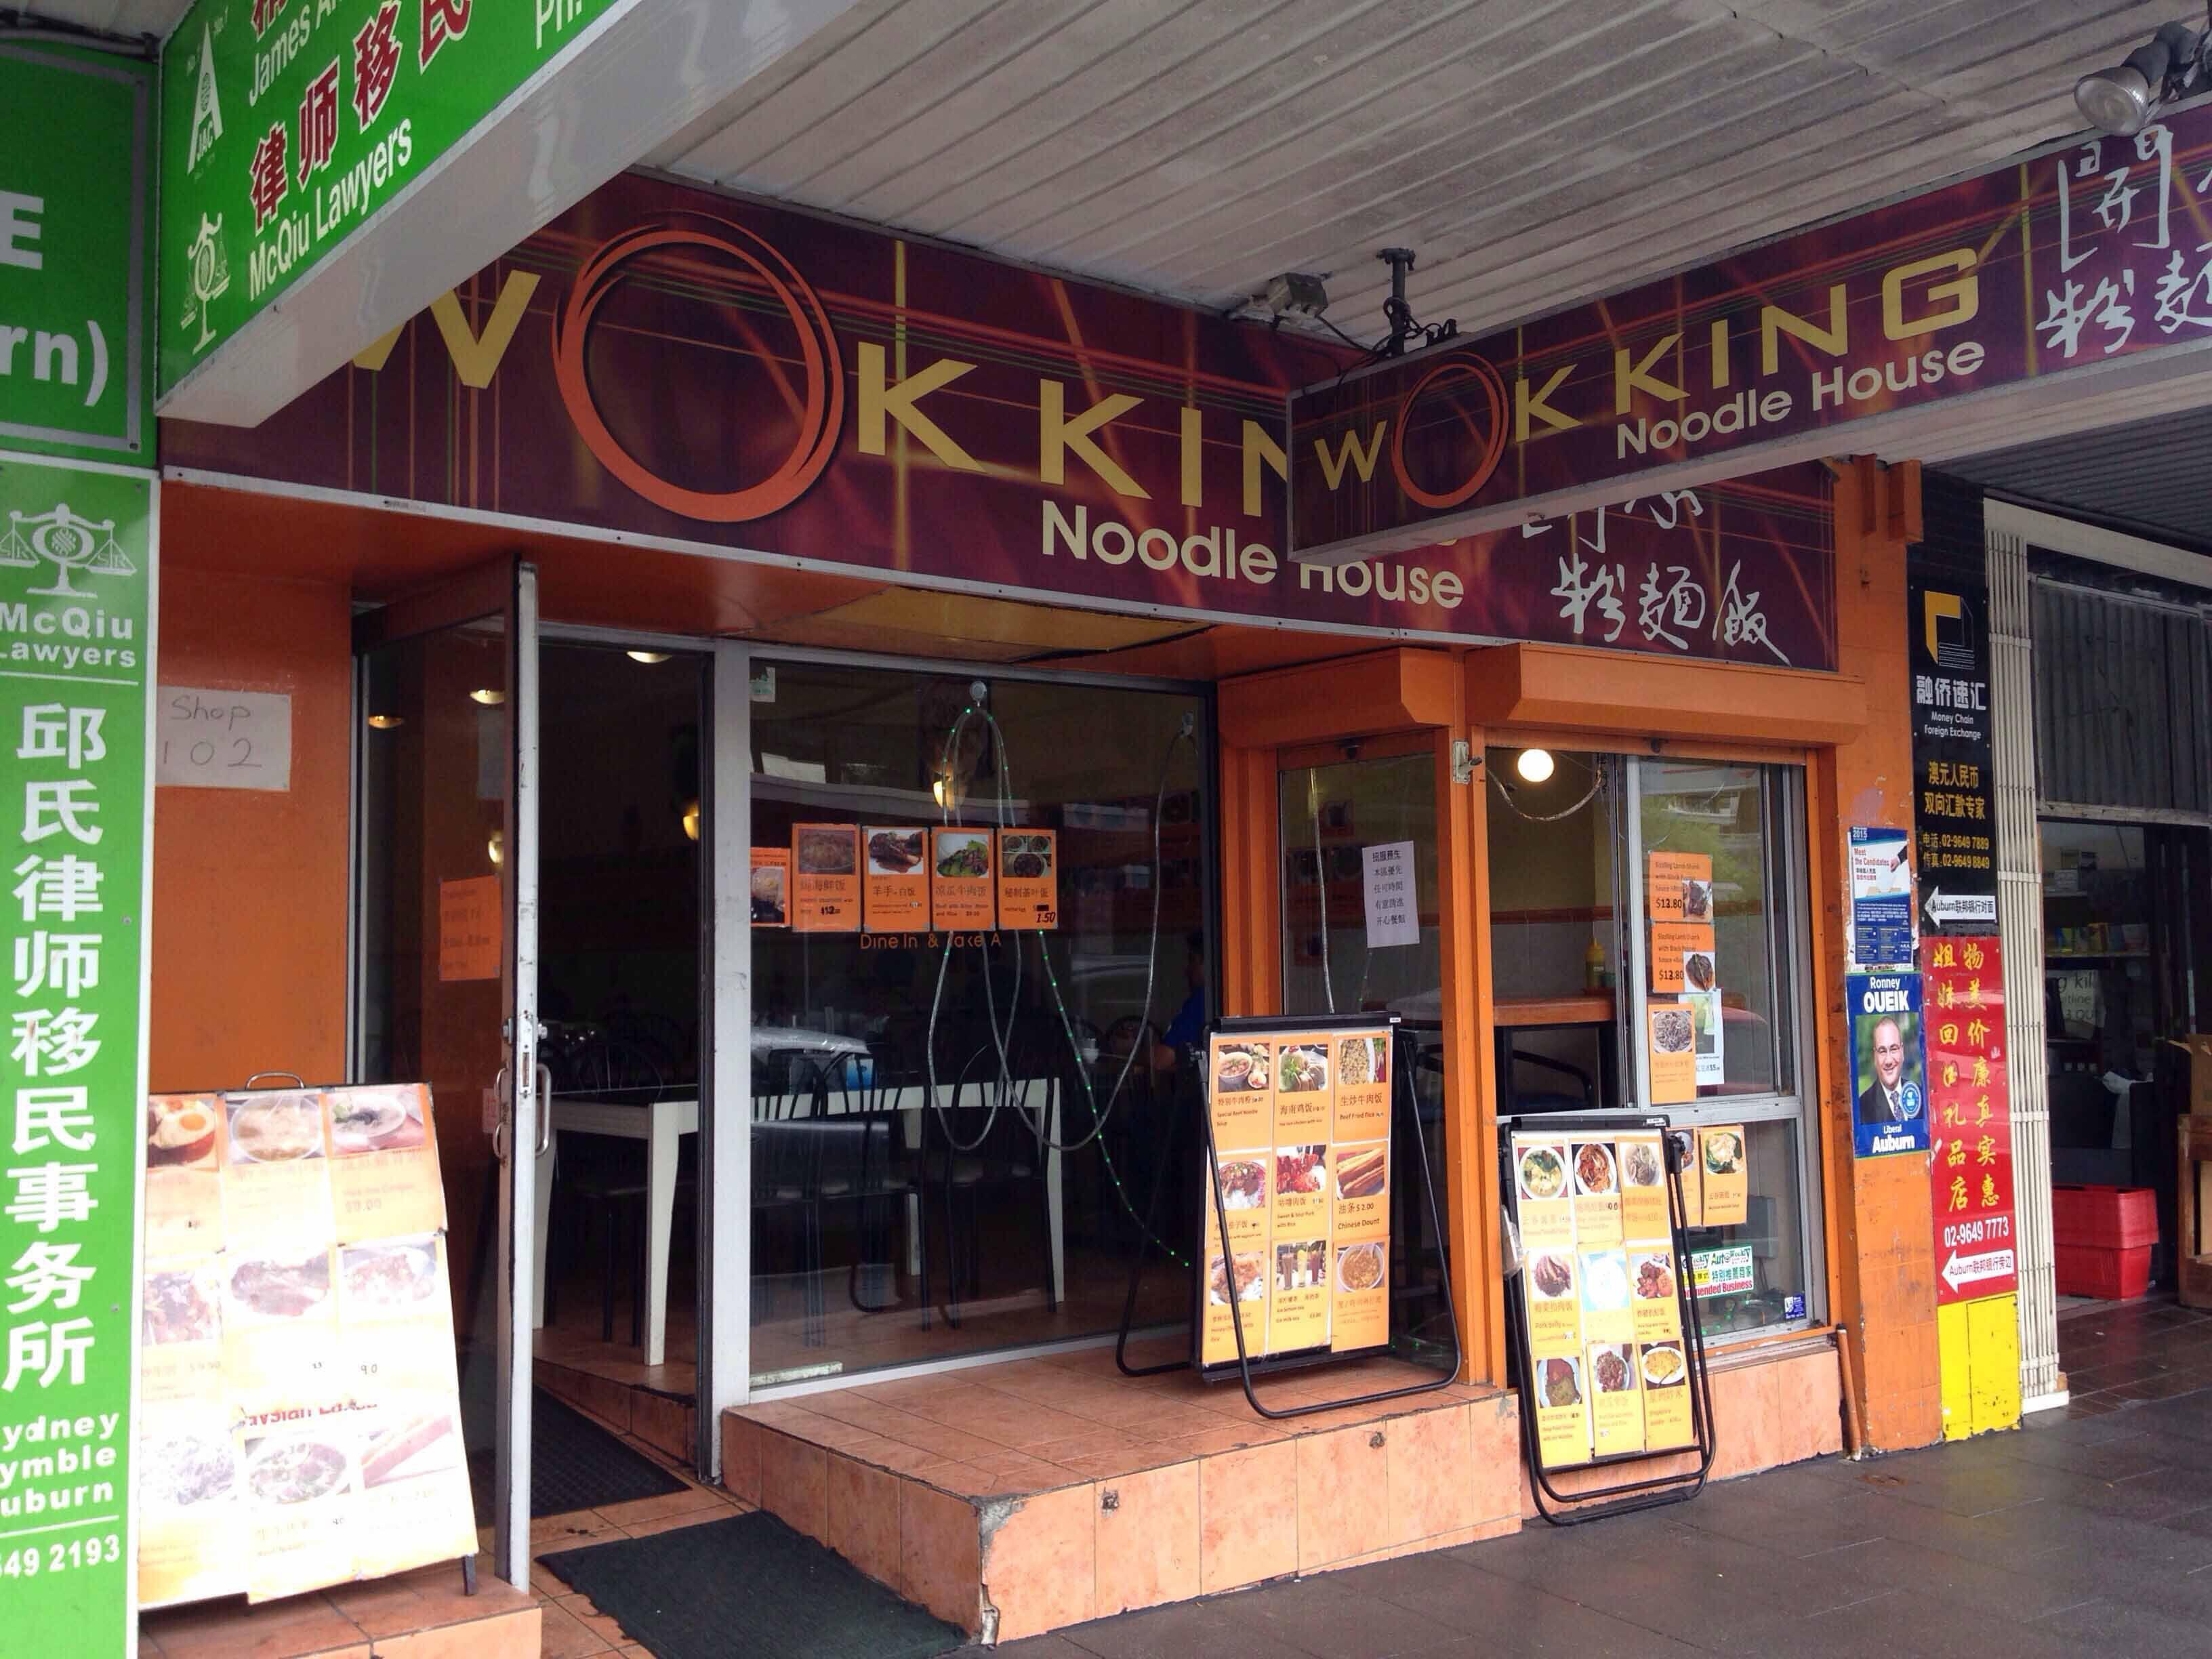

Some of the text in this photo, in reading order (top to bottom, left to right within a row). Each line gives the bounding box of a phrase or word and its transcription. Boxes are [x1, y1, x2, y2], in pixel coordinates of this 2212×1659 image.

[249, 5, 310, 107] James
[249, 118, 412, 302] McQiu Lawyers
[1313, 247, 1982, 508] WOK KING
[1617, 339, 1985, 459] Noodle House
[1042, 499, 1278, 583] Noodle
[0, 602, 133, 640] McQiu
[0, 641, 136, 669] awyers
[1916, 675, 1987, 711] 融侨速汇
[171, 695, 251, 731] Shop
[1931, 711, 1974, 724] Money Chain
[1924, 724, 1982, 741] Foreign Exchange
[1928, 761, 1980, 789] 澳元人民币
[1924, 792, 1986, 820] 双向汇款专家
[860, 933, 899, 949] Dine
[904, 933, 918, 948] In
[1870, 976, 1901, 990] Ronney
[1864, 990, 1910, 1013] OUEIK
[3, 702, 107, 1395] 邱氏律师移民事务所
[1872, 1134, 1915, 1153] Auburn
[1883, 1124, 1902, 1134] Liberal
[1944, 1216, 2009, 1248] 02-9649 7773
[1, 1411, 120, 1452] ydney
[0, 1444, 117, 1489] ymble
[0, 1481, 114, 1517] uburn
[0, 1534, 120, 1578] 49 2193
